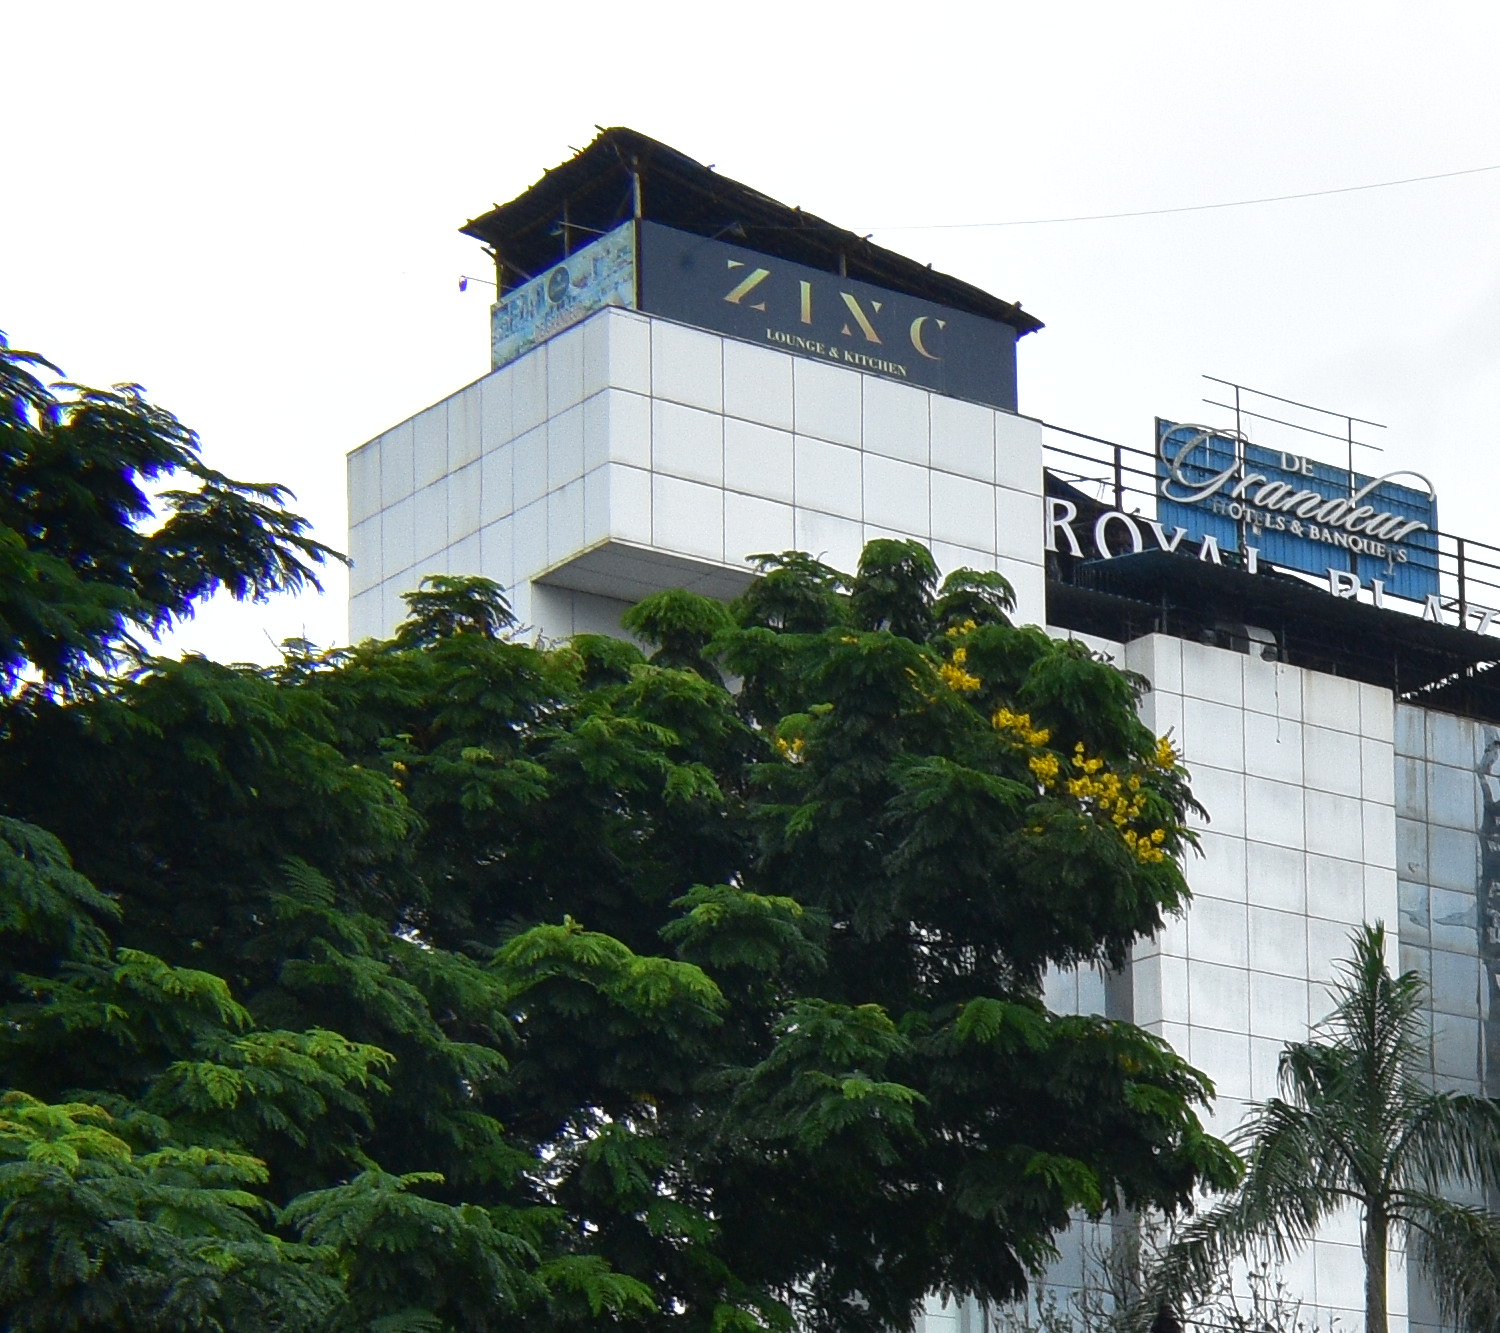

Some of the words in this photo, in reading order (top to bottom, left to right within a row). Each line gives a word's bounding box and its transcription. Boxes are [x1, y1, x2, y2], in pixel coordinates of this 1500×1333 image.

[723, 260, 947, 361] ZINC
[766, 328, 826, 355] LOUNGE
[828, 347, 839, 358] &
[844, 350, 908, 377] KITCHEN
[1160, 423, 1437, 542] Grandeur
[1281, 451, 1315, 478] DE
[1212, 501, 1286, 532] HOTELS
[1290, 518, 1305, 535] &
[1309, 525, 1408, 564] BANQUETS
